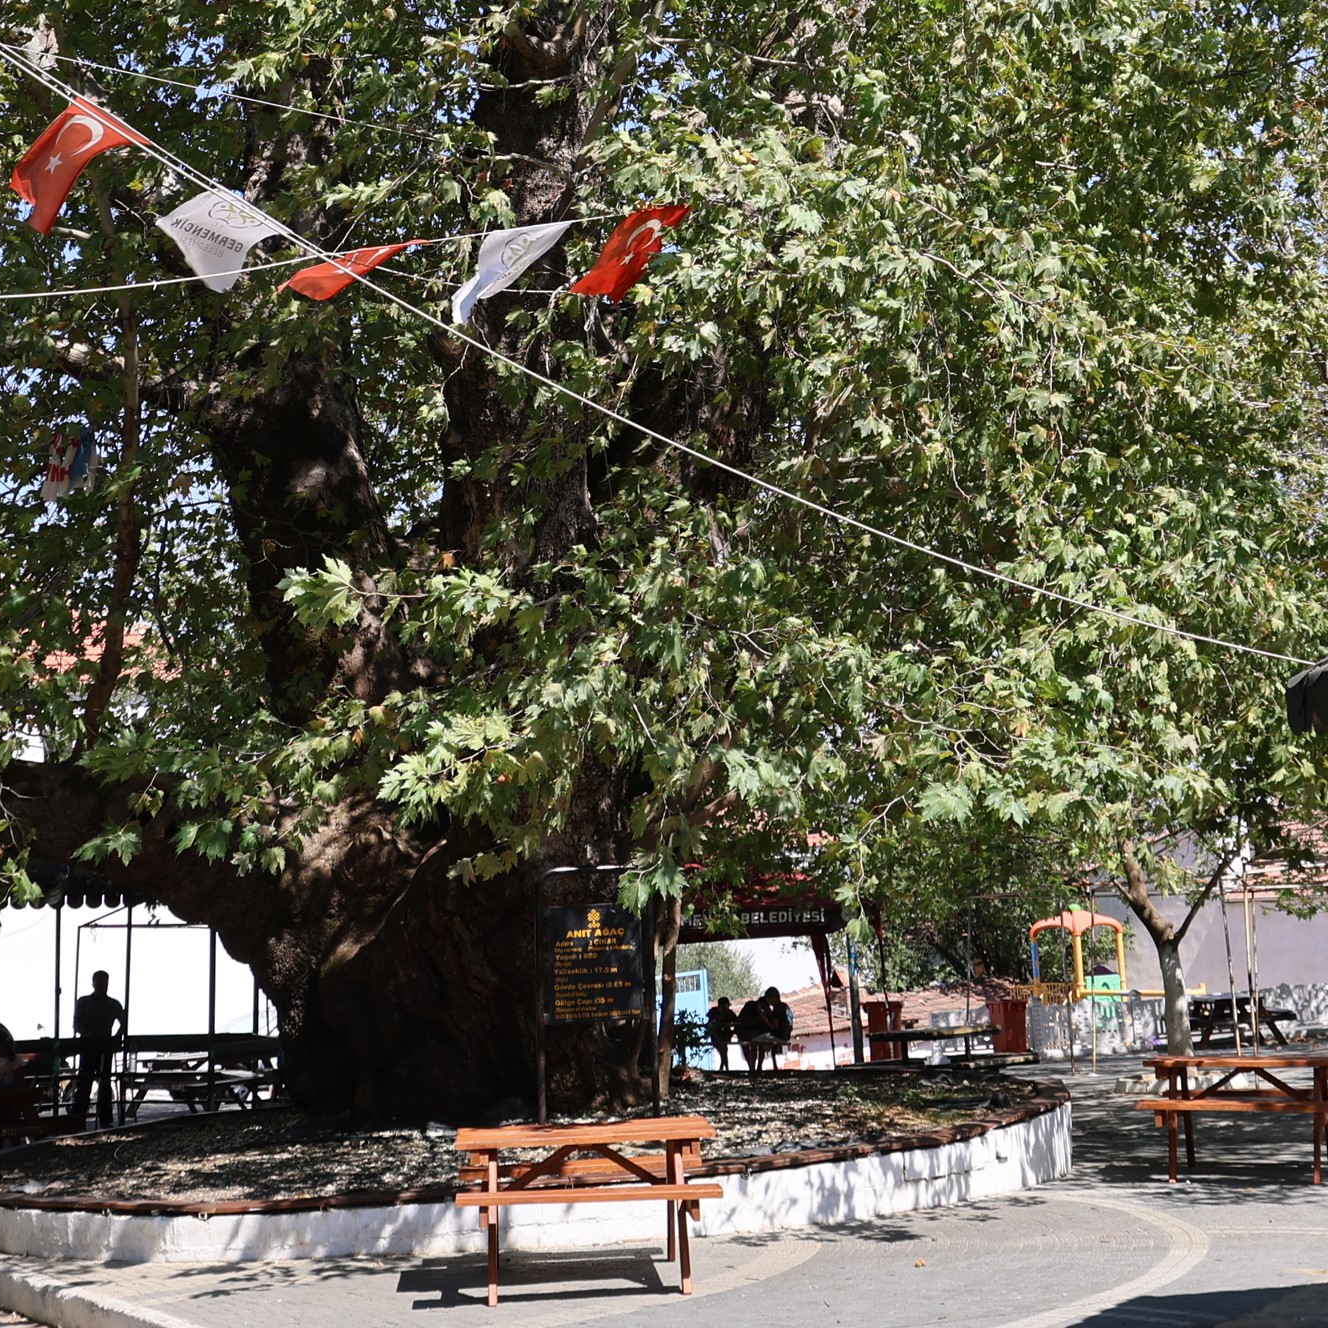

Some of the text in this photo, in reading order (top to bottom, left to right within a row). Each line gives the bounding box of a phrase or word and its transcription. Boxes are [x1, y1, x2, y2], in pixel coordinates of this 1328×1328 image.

[741, 907, 826, 925] BELEDİYESİ
[566, 928, 625, 938] ANIT AĞAÇ
